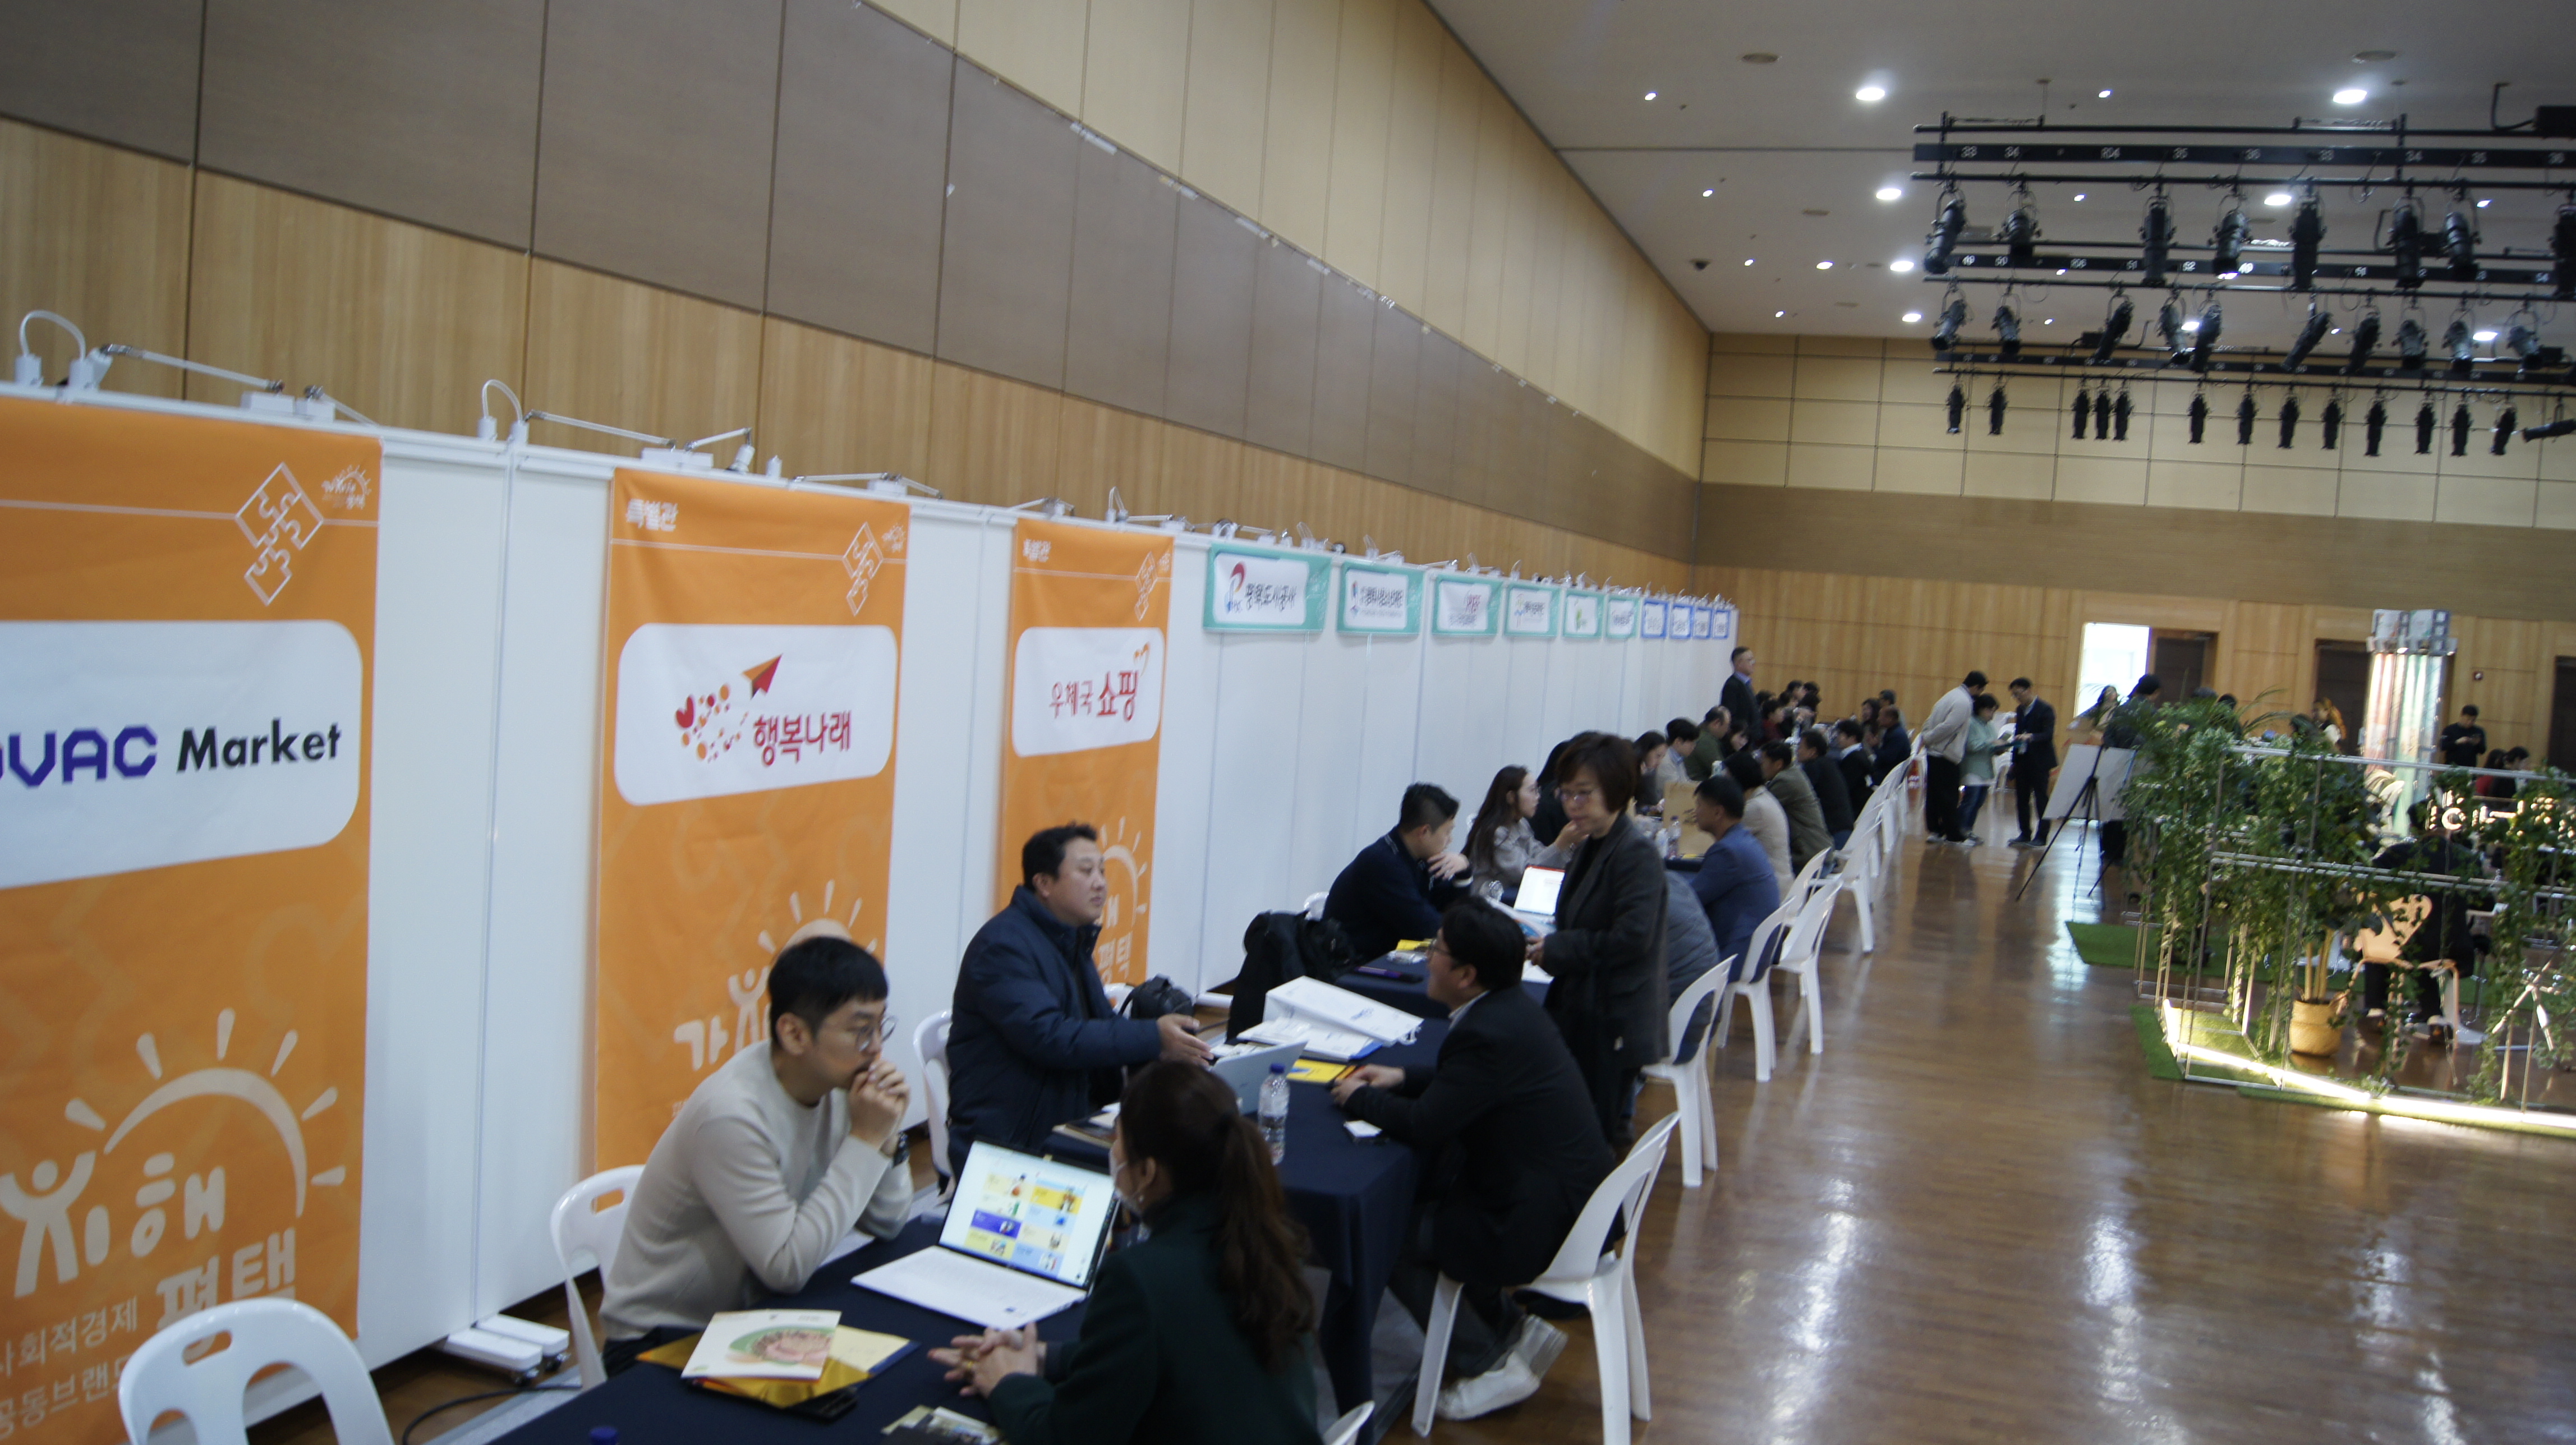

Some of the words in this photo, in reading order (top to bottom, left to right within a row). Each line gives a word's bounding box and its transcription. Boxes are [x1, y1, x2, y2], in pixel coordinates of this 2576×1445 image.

[1097, 670, 1139, 722] 쇼핑
[0, 724, 158, 787] VAC
[176, 717, 341, 774] Market
[752, 710, 852, 767] 행복나래
